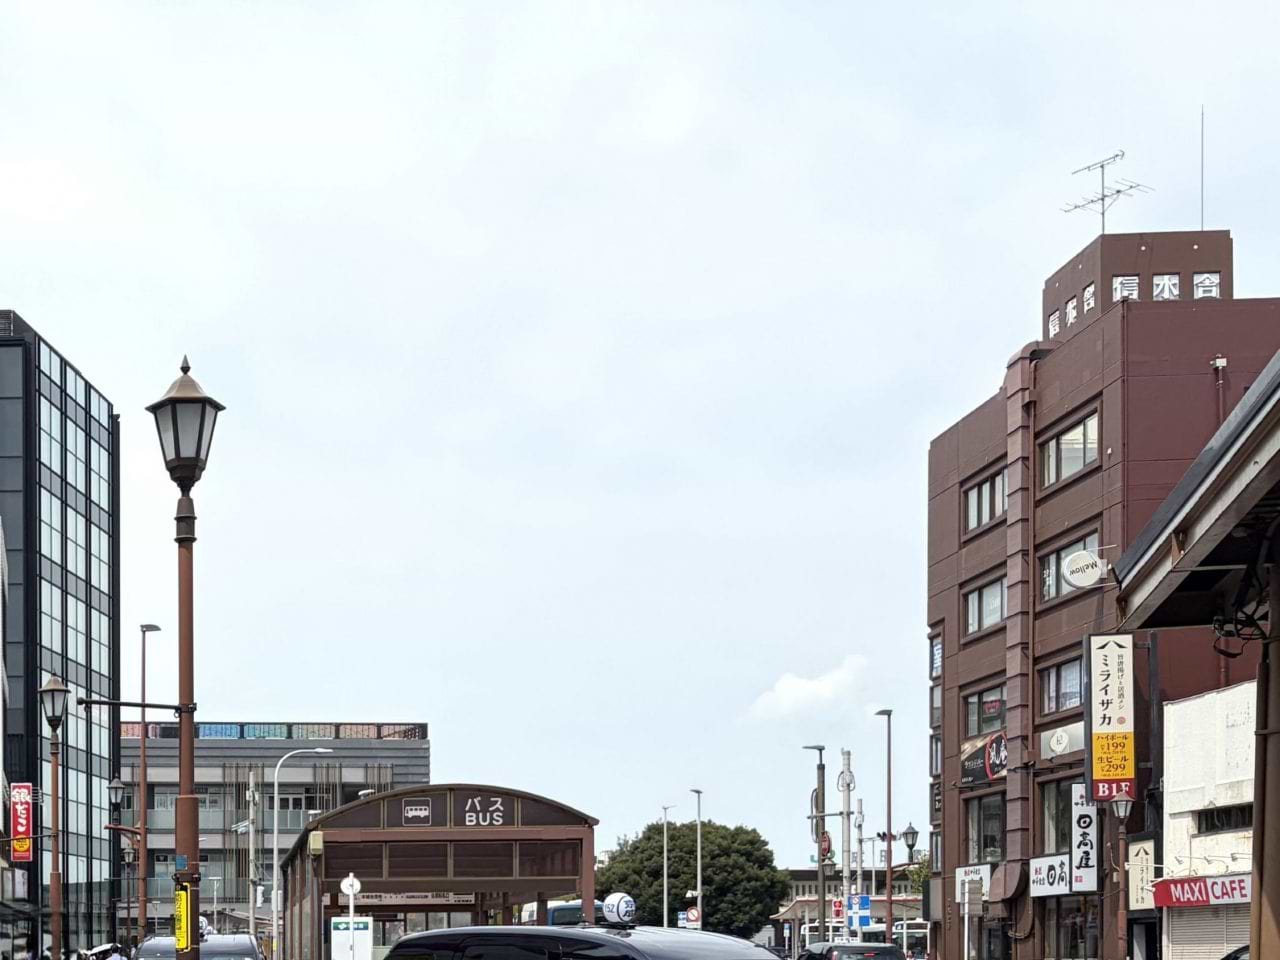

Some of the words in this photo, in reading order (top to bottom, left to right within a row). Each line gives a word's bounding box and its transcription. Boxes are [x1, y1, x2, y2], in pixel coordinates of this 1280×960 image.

[1070, 561, 1098, 576] Mellow
[1099, 654, 1113, 728] ミライザカ
[1097, 782, 1131, 797] B1F
[464, 796, 504, 812] バス
[464, 812, 504, 826] BUS
[1170, 881, 1208, 903] MAXI
[1210, 878, 1248, 901] CAFE
[605, 904, 615, 914] 152
